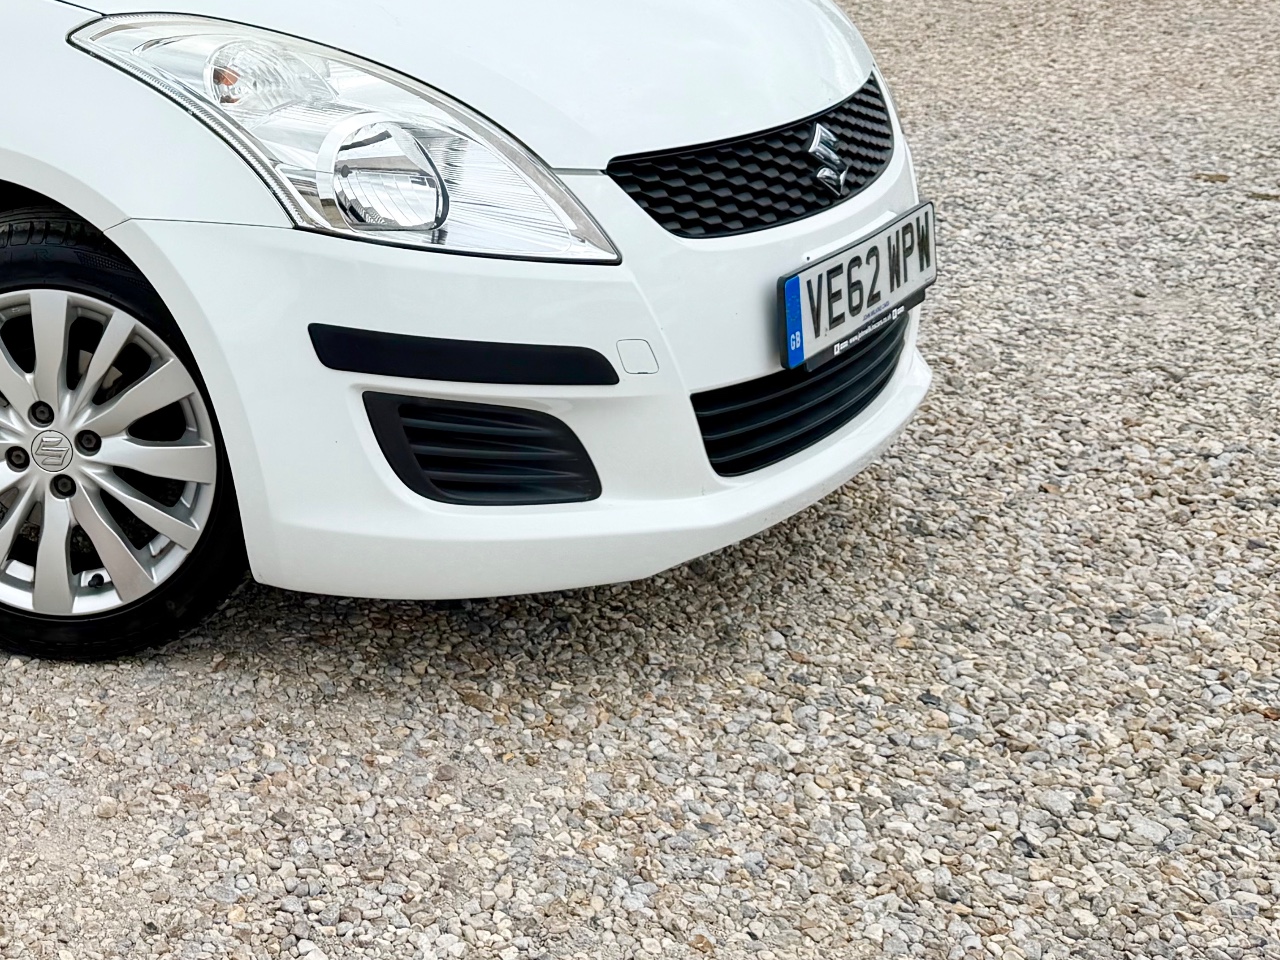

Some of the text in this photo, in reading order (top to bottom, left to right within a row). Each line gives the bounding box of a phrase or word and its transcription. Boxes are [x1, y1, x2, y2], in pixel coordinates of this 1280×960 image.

[806, 211, 931, 339] VE62 WPW
[790, 331, 801, 351] GB
